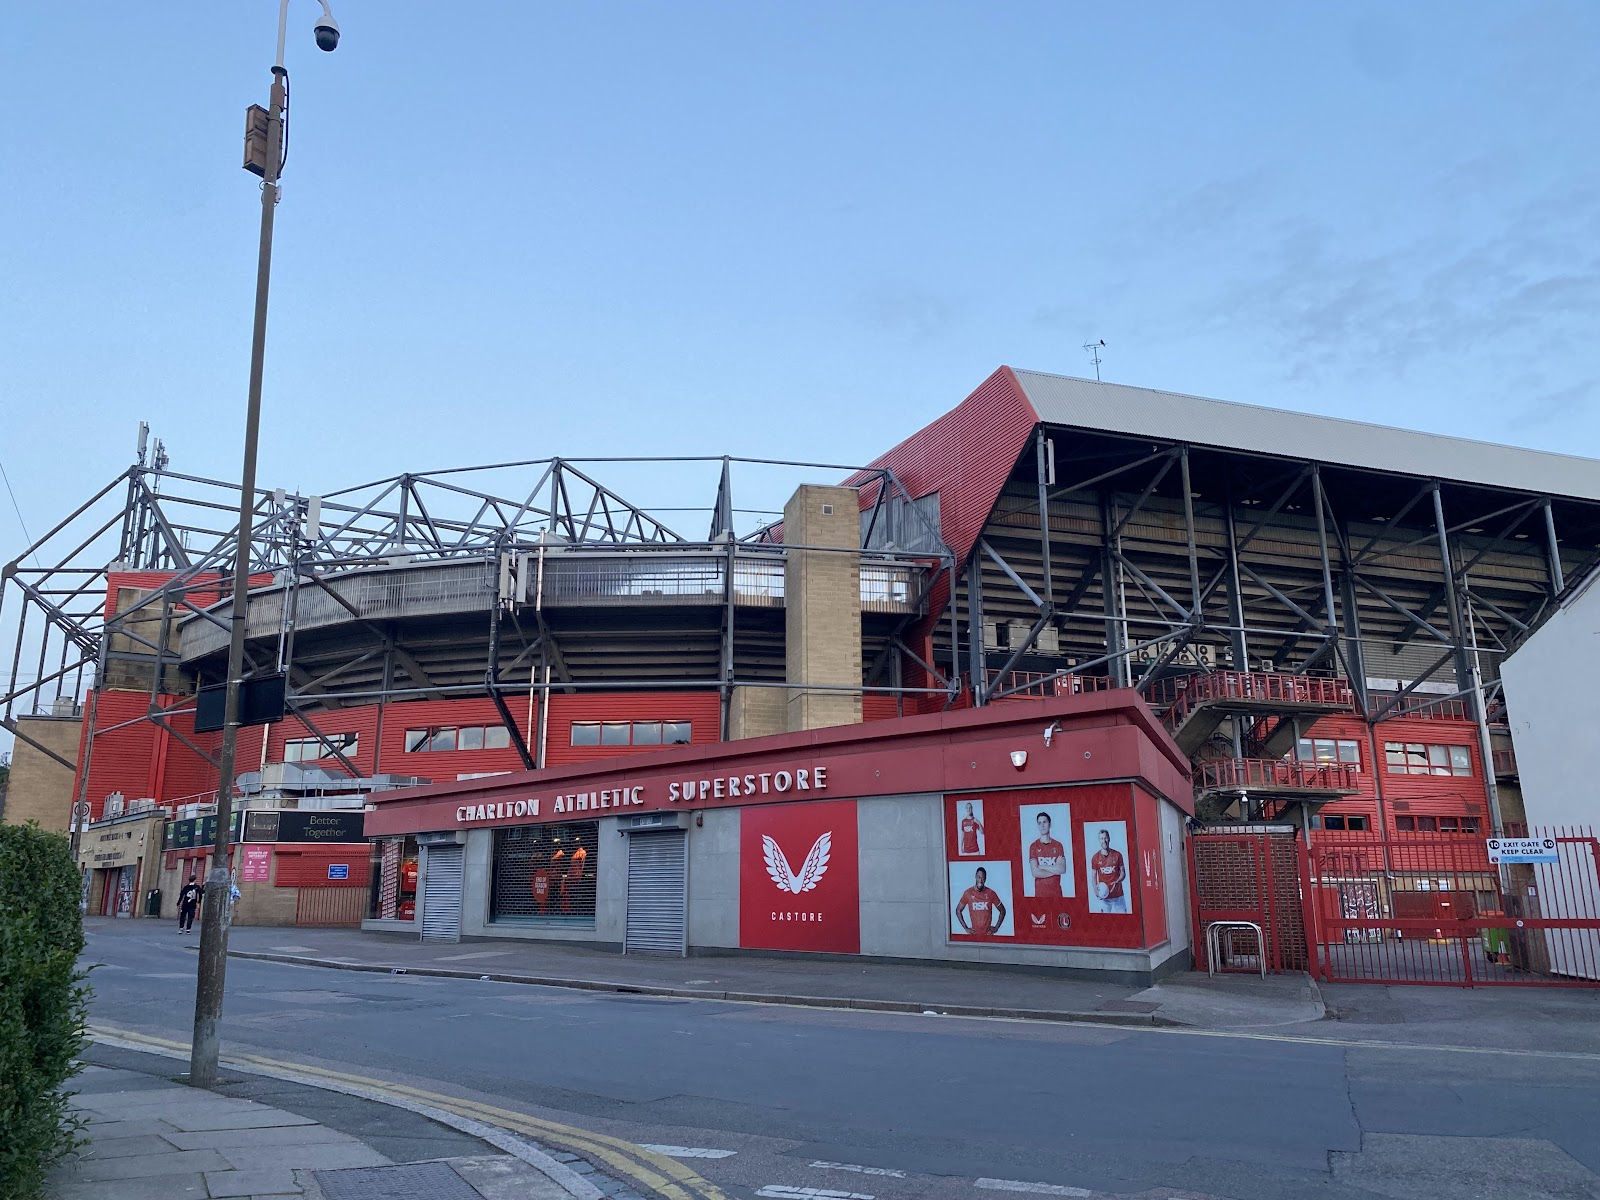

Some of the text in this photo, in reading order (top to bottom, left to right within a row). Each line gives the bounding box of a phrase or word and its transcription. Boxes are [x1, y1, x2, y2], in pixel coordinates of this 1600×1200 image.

[456, 766, 828, 823] CHARLTON ATHLETIC SUPERSTORE
[309, 815, 342, 826] Better
[303, 826, 347, 839] Together
[1038, 857, 1056, 866] RSK
[1100, 866, 1116, 874] RSK
[972, 902, 989, 911] RSK
[771, 911, 823, 923] CASTORE
